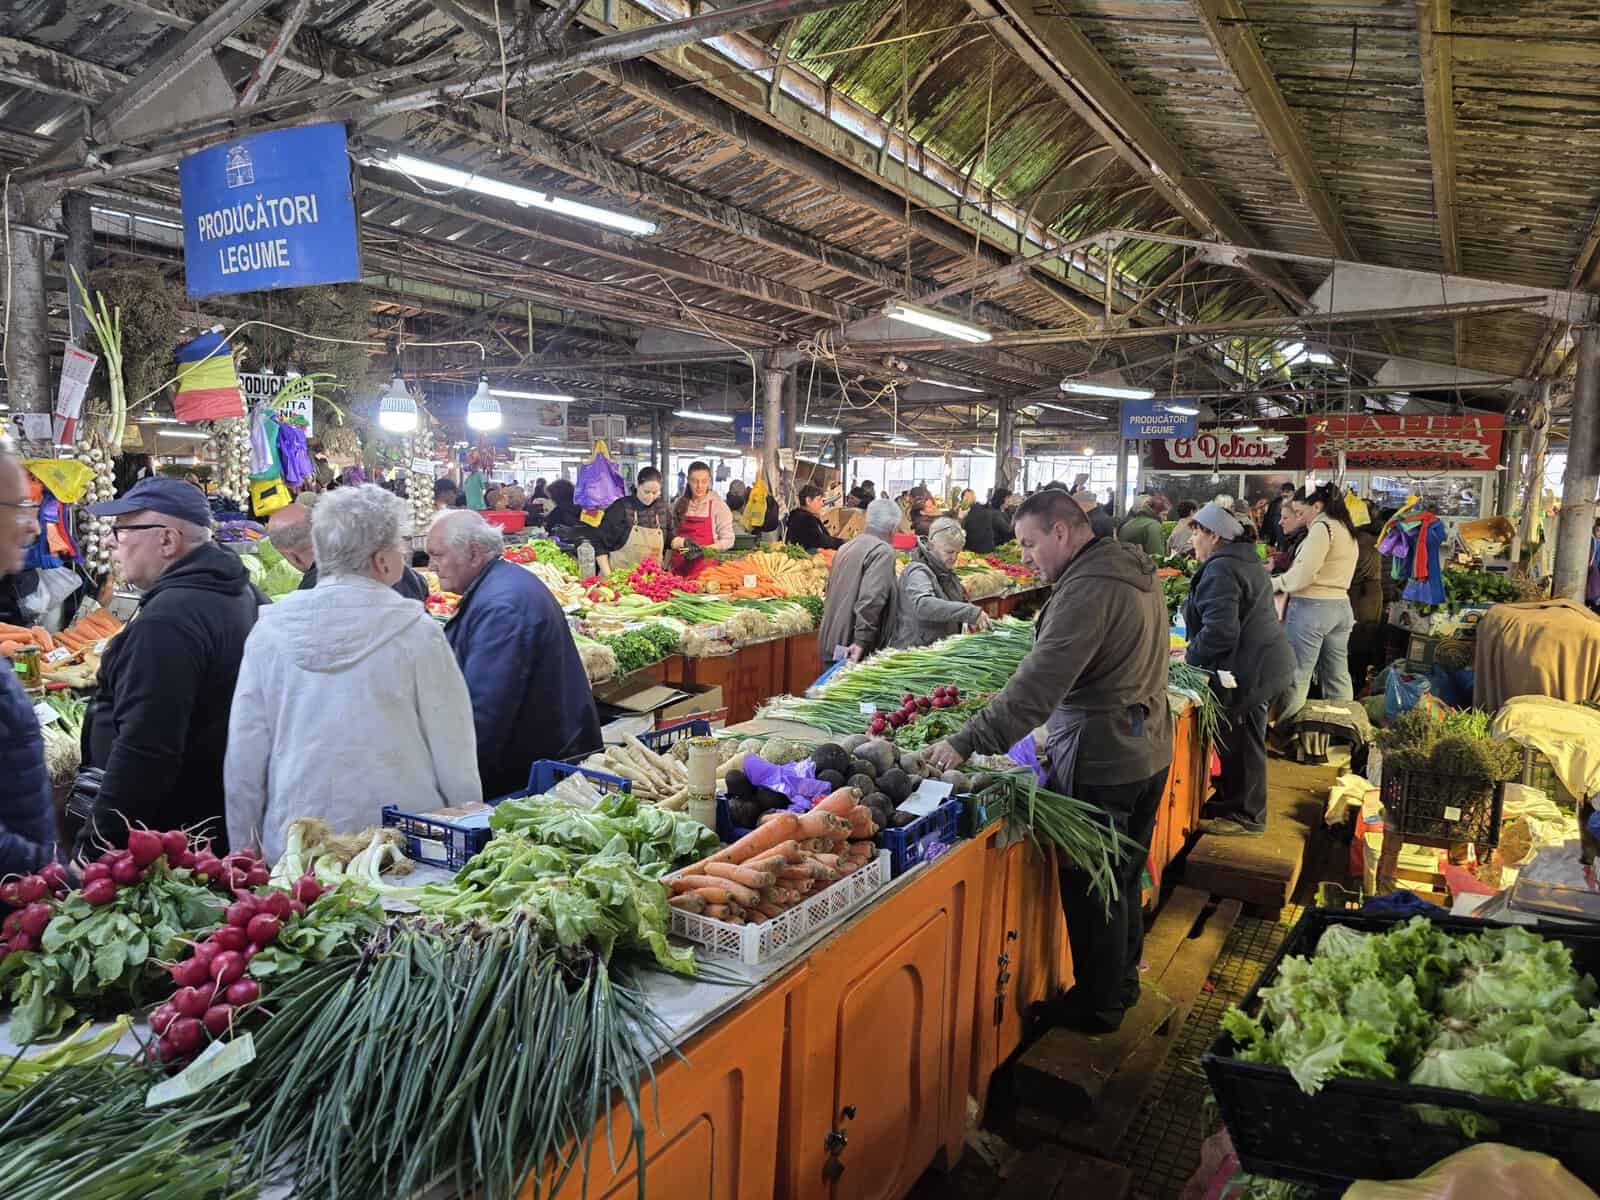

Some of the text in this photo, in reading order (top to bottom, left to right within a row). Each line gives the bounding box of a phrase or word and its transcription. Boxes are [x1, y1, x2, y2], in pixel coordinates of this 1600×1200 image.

[198, 193, 318, 242] PRODUCĂTORI
[219, 238, 291, 275] LEGUME
[1141, 425, 1177, 434] LEGUME
